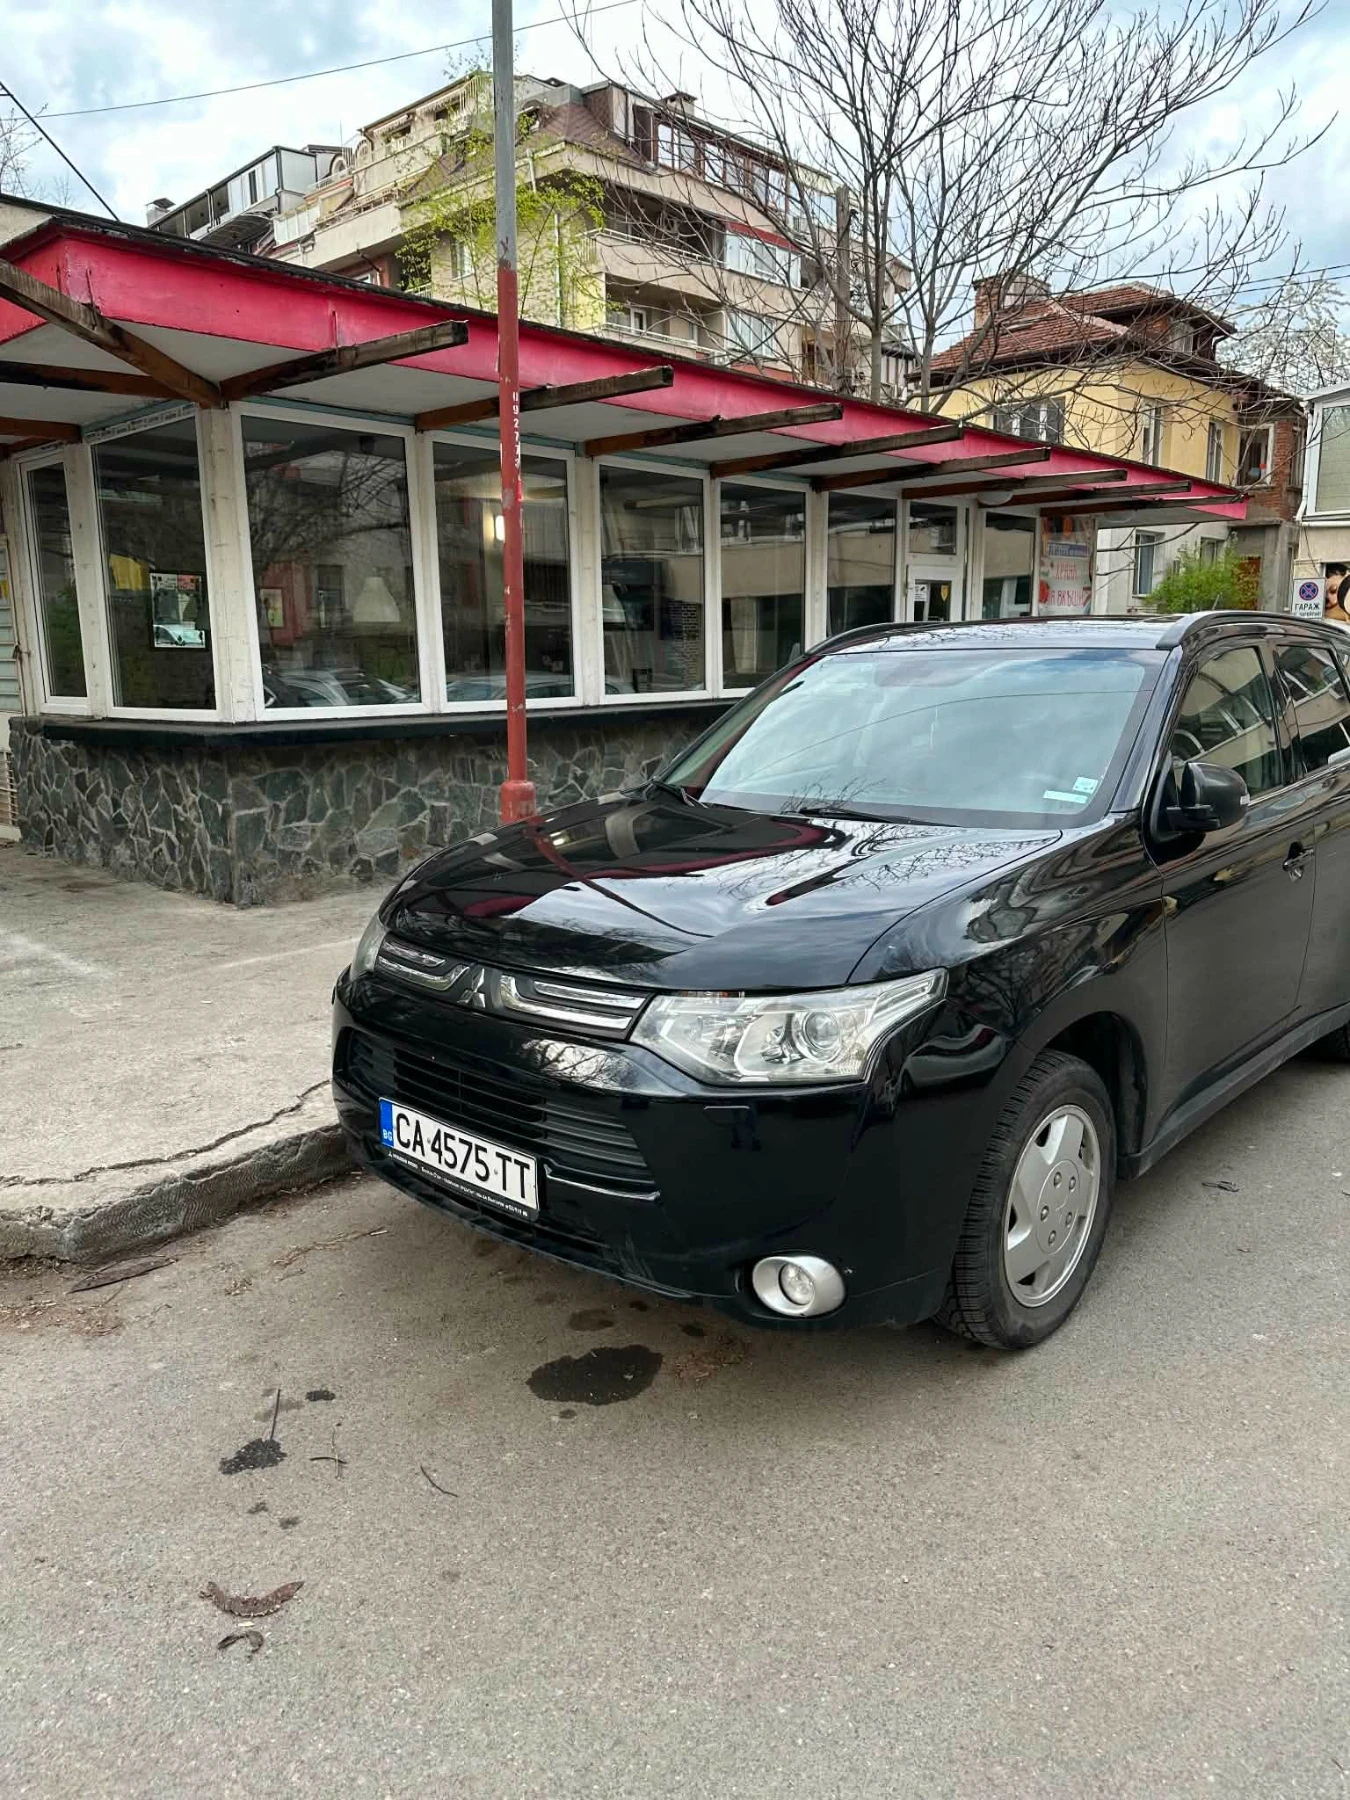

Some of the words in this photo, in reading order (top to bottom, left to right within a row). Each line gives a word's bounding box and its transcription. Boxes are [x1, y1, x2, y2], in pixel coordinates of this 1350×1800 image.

[382, 1128, 393, 1141] BG
[396, 1113, 425, 1157] CA
[430, 1128, 490, 1182] 4575
[495, 1151, 530, 1199] TT
